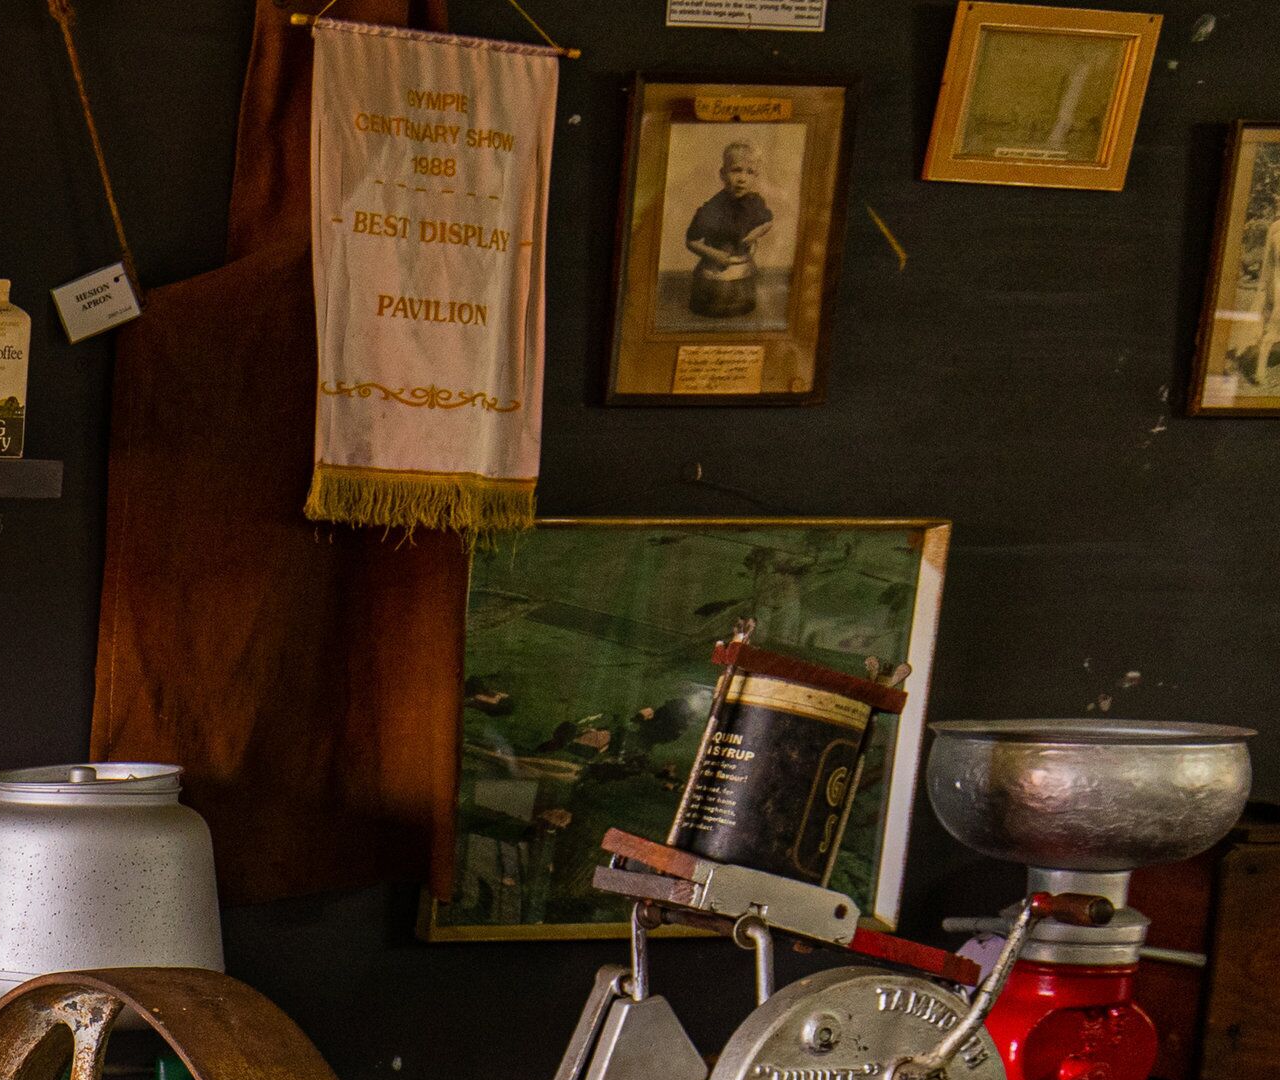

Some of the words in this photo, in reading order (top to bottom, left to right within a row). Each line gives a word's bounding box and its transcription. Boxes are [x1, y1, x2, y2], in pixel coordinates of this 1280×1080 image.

[407, 89, 469, 114] GYMPIE
[354, 112, 460, 144] CENTENARY
[466, 129, 514, 152] SHOW
[412, 156, 457, 178] 1988
[352, 211, 411, 239] BEST
[419, 219, 511, 252] DISPLAY
[81, 293, 112, 312] APRON
[377, 294, 488, 327] PAVILION
[713, 746, 755, 760] SYRUP
